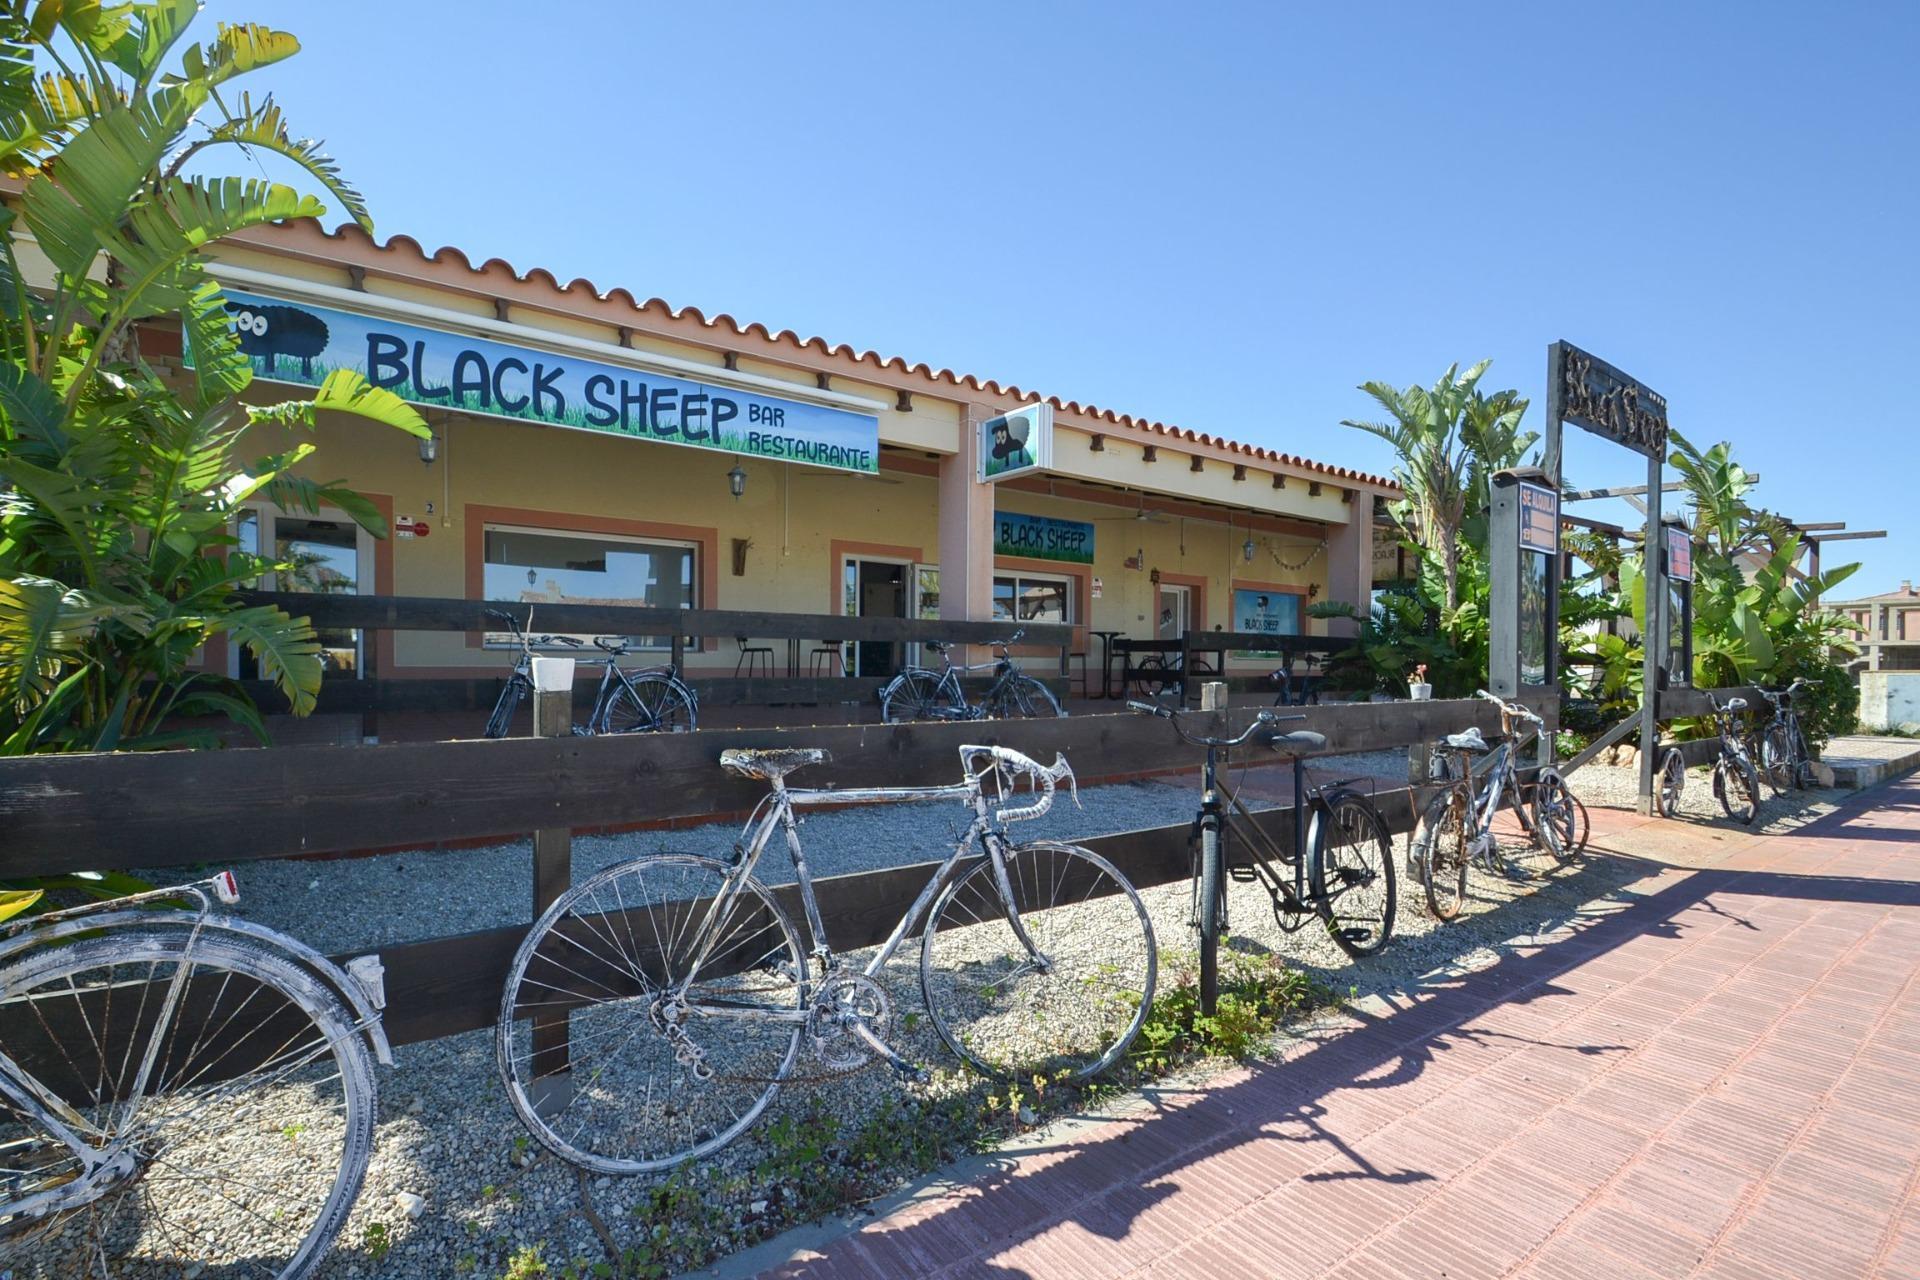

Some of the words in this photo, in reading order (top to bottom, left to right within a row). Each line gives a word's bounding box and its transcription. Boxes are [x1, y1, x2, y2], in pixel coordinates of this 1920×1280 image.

[366, 332, 565, 420] BLACK
[584, 374, 738, 445] SHEEP
[749, 403, 785, 428] BAR
[749, 431, 871, 469] RESTAURANTE
[426, 503, 434, 514] 2
[1001, 522, 1044, 549] BLACK
[1047, 528, 1087, 552] SHEEP
